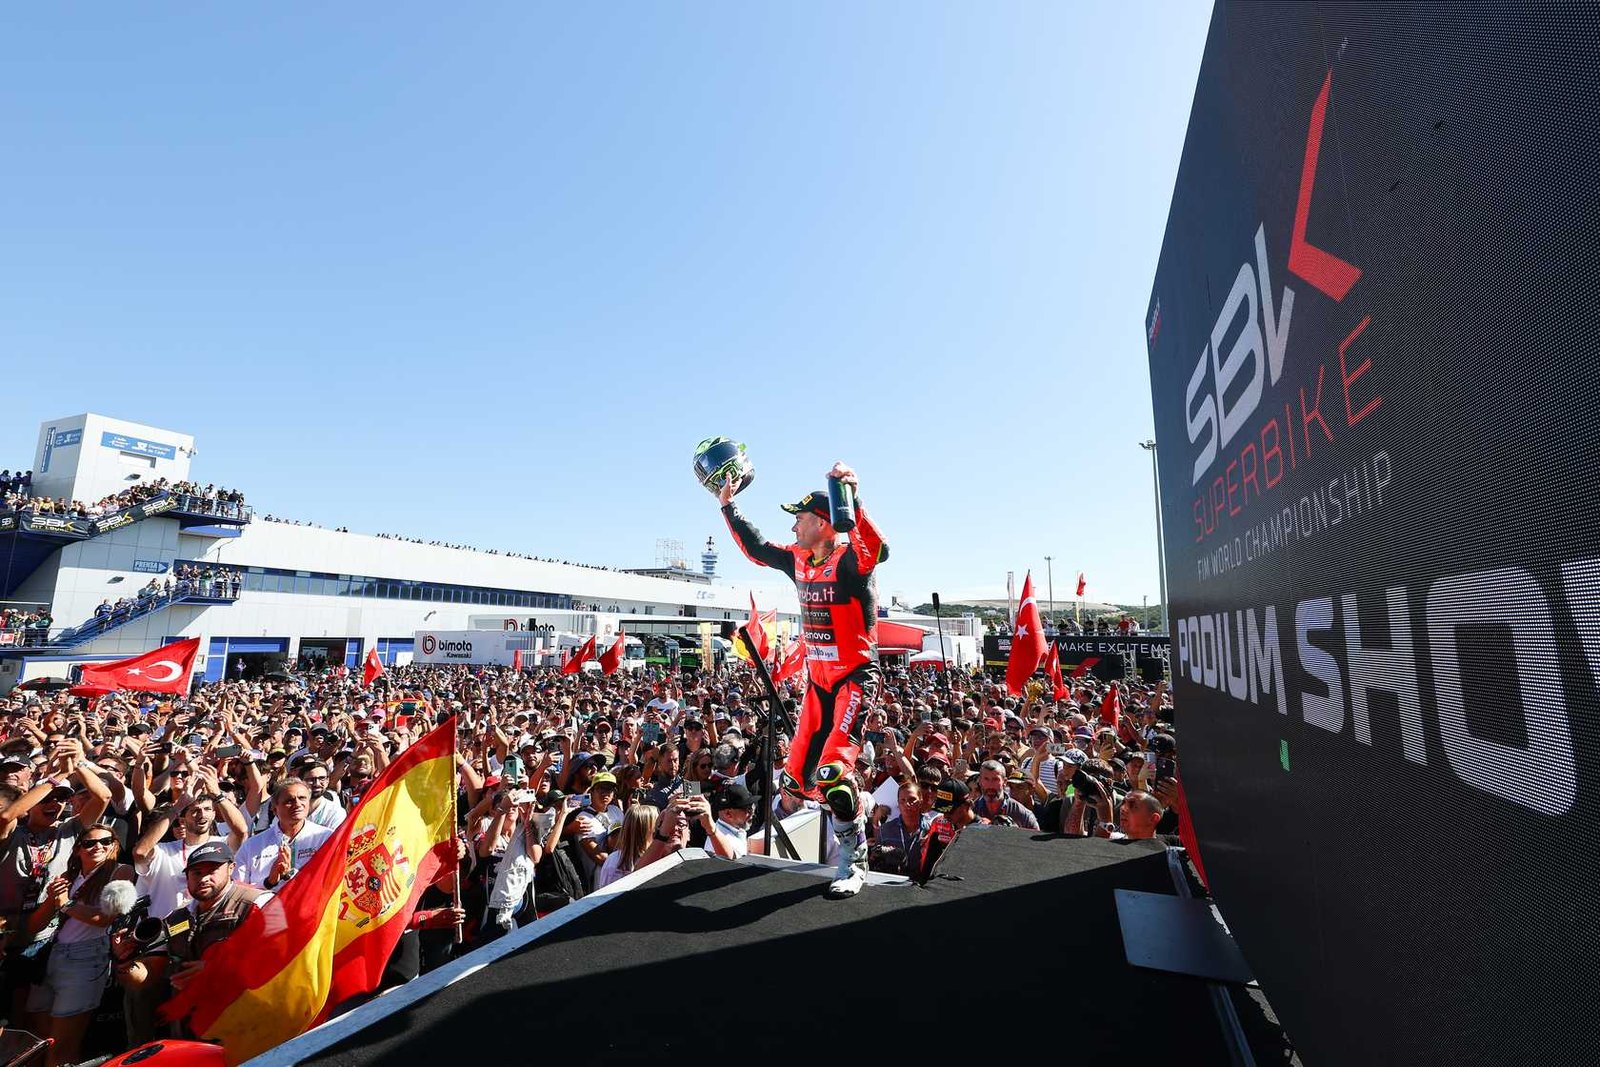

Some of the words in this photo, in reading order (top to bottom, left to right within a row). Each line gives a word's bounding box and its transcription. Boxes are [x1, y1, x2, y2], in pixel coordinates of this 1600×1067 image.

[1186, 64, 1363, 487] SBK
[1193, 314, 1383, 542] SUPERBIKE
[96, 512, 132, 528] SBK
[1197, 555, 1211, 582] FIM
[1210, 537, 1242, 577] WORLD
[1245, 449, 1392, 562] CHAMPIONSHIP
[438, 640, 472, 651] bimota
[1058, 641, 1094, 653] MAKE
[1177, 604, 1287, 716] PODIUM
[840, 690, 862, 734] DUCATI
